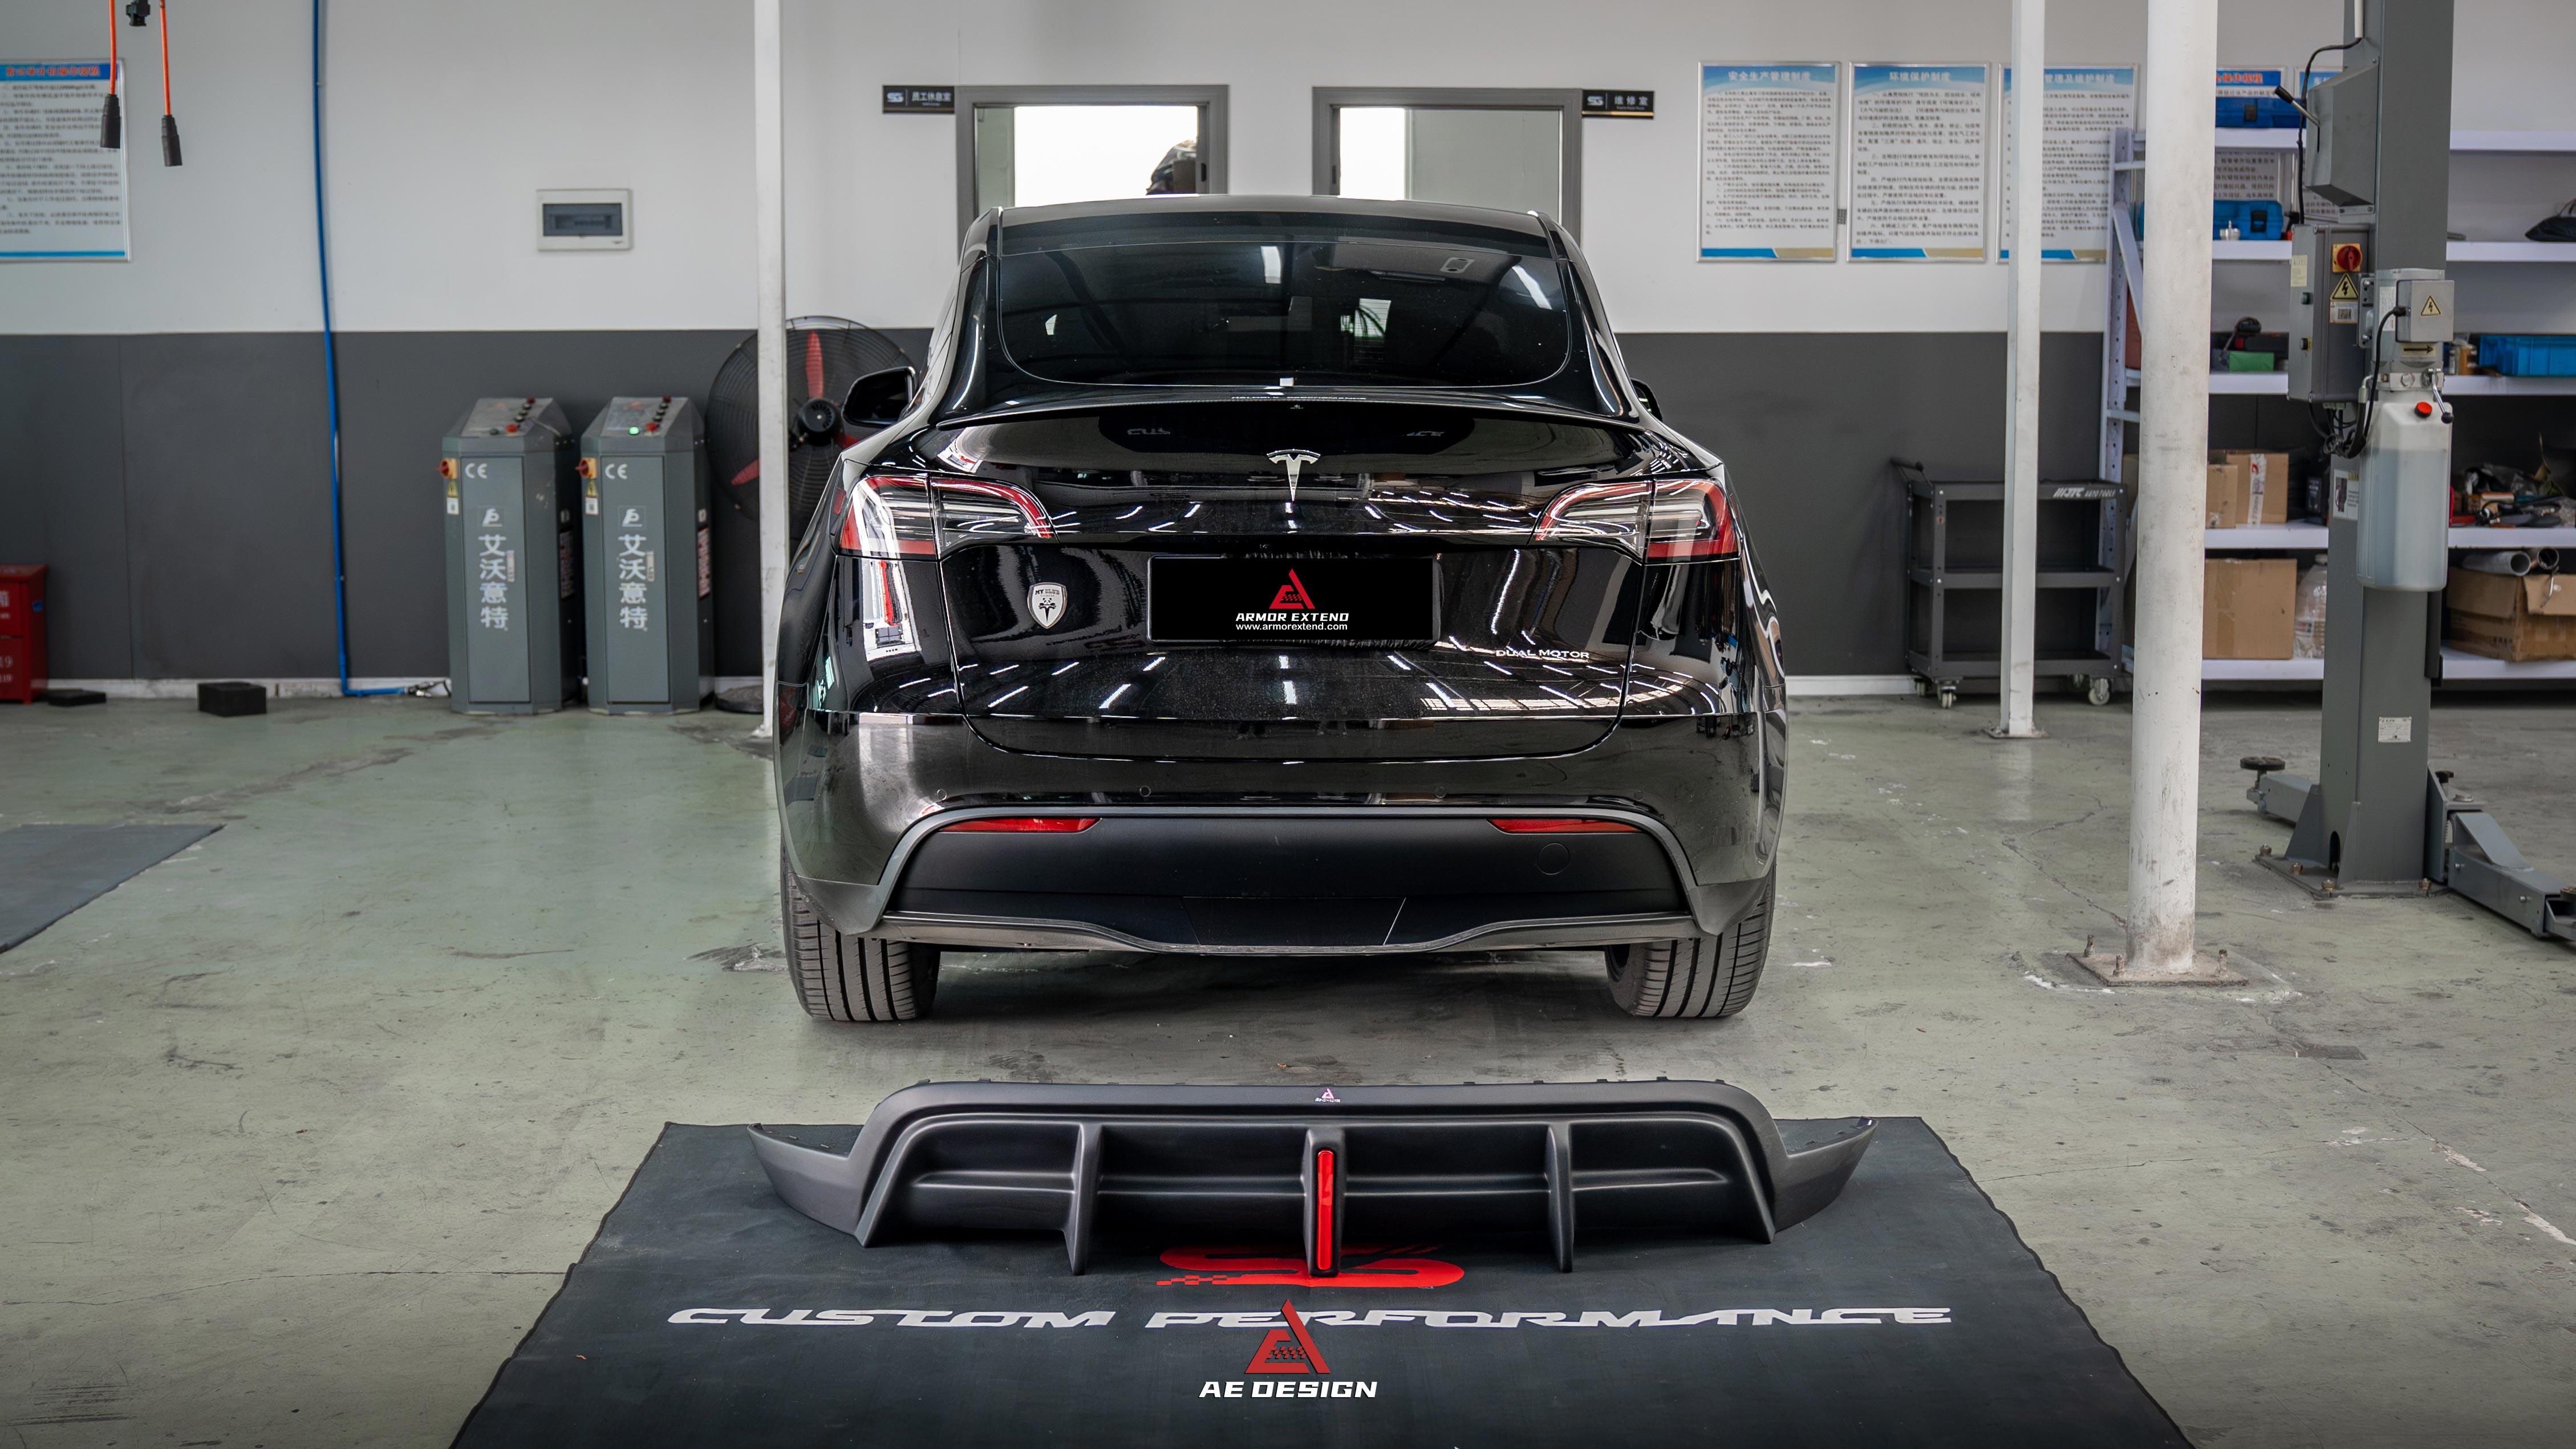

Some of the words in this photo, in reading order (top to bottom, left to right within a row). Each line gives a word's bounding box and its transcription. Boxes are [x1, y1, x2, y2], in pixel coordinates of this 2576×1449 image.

[1728, 71, 1811, 81] 安全生产管理制度
[1889, 71, 1952, 82] 环境保护制度
[465, 463, 487, 478] CE
[605, 463, 627, 479] CE
[478, 534, 508, 628] 艾沃意特
[618, 534, 648, 628] 艾沃意特
[1539, 650, 1590, 659] MOTOR
[668, 1308, 1115, 1328] CUSTOM
[1145, 1308, 1952, 1329] PERFORMANCE
